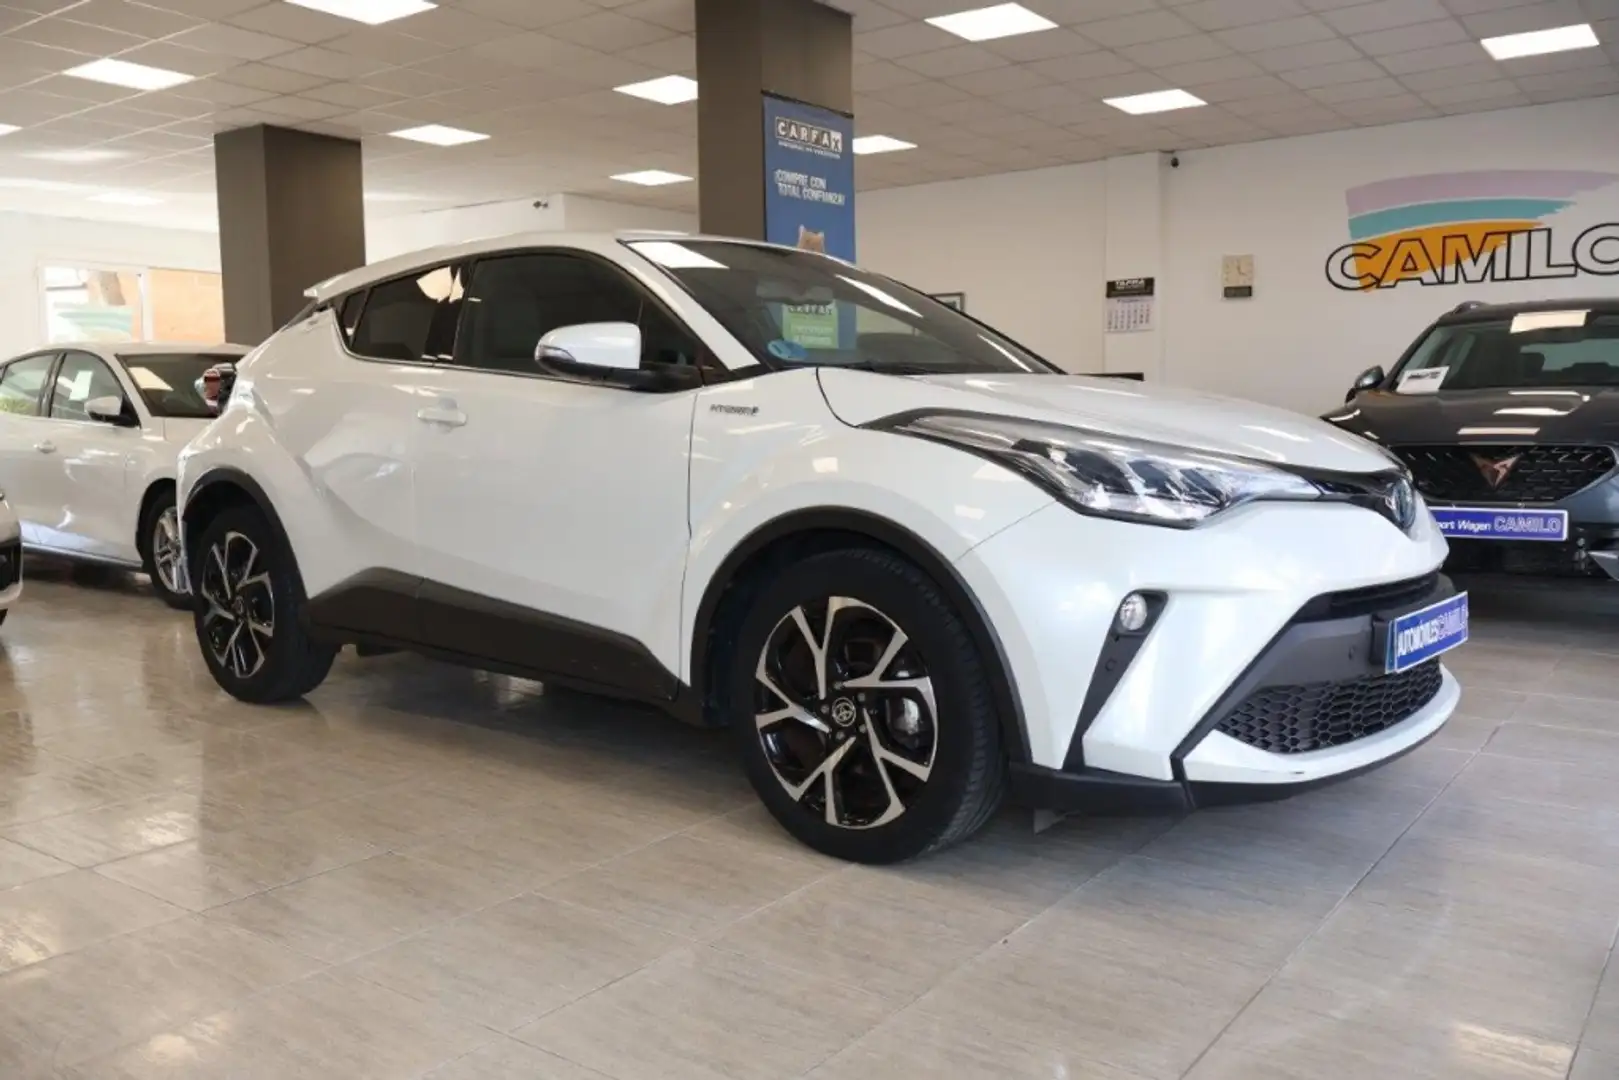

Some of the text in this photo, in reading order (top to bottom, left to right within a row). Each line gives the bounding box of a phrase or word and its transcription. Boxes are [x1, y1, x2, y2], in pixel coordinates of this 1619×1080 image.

[777, 121, 841, 151] CARFAX
[1325, 222, 1619, 290] CAMILO
[1493, 515, 1560, 533] CAMILO
